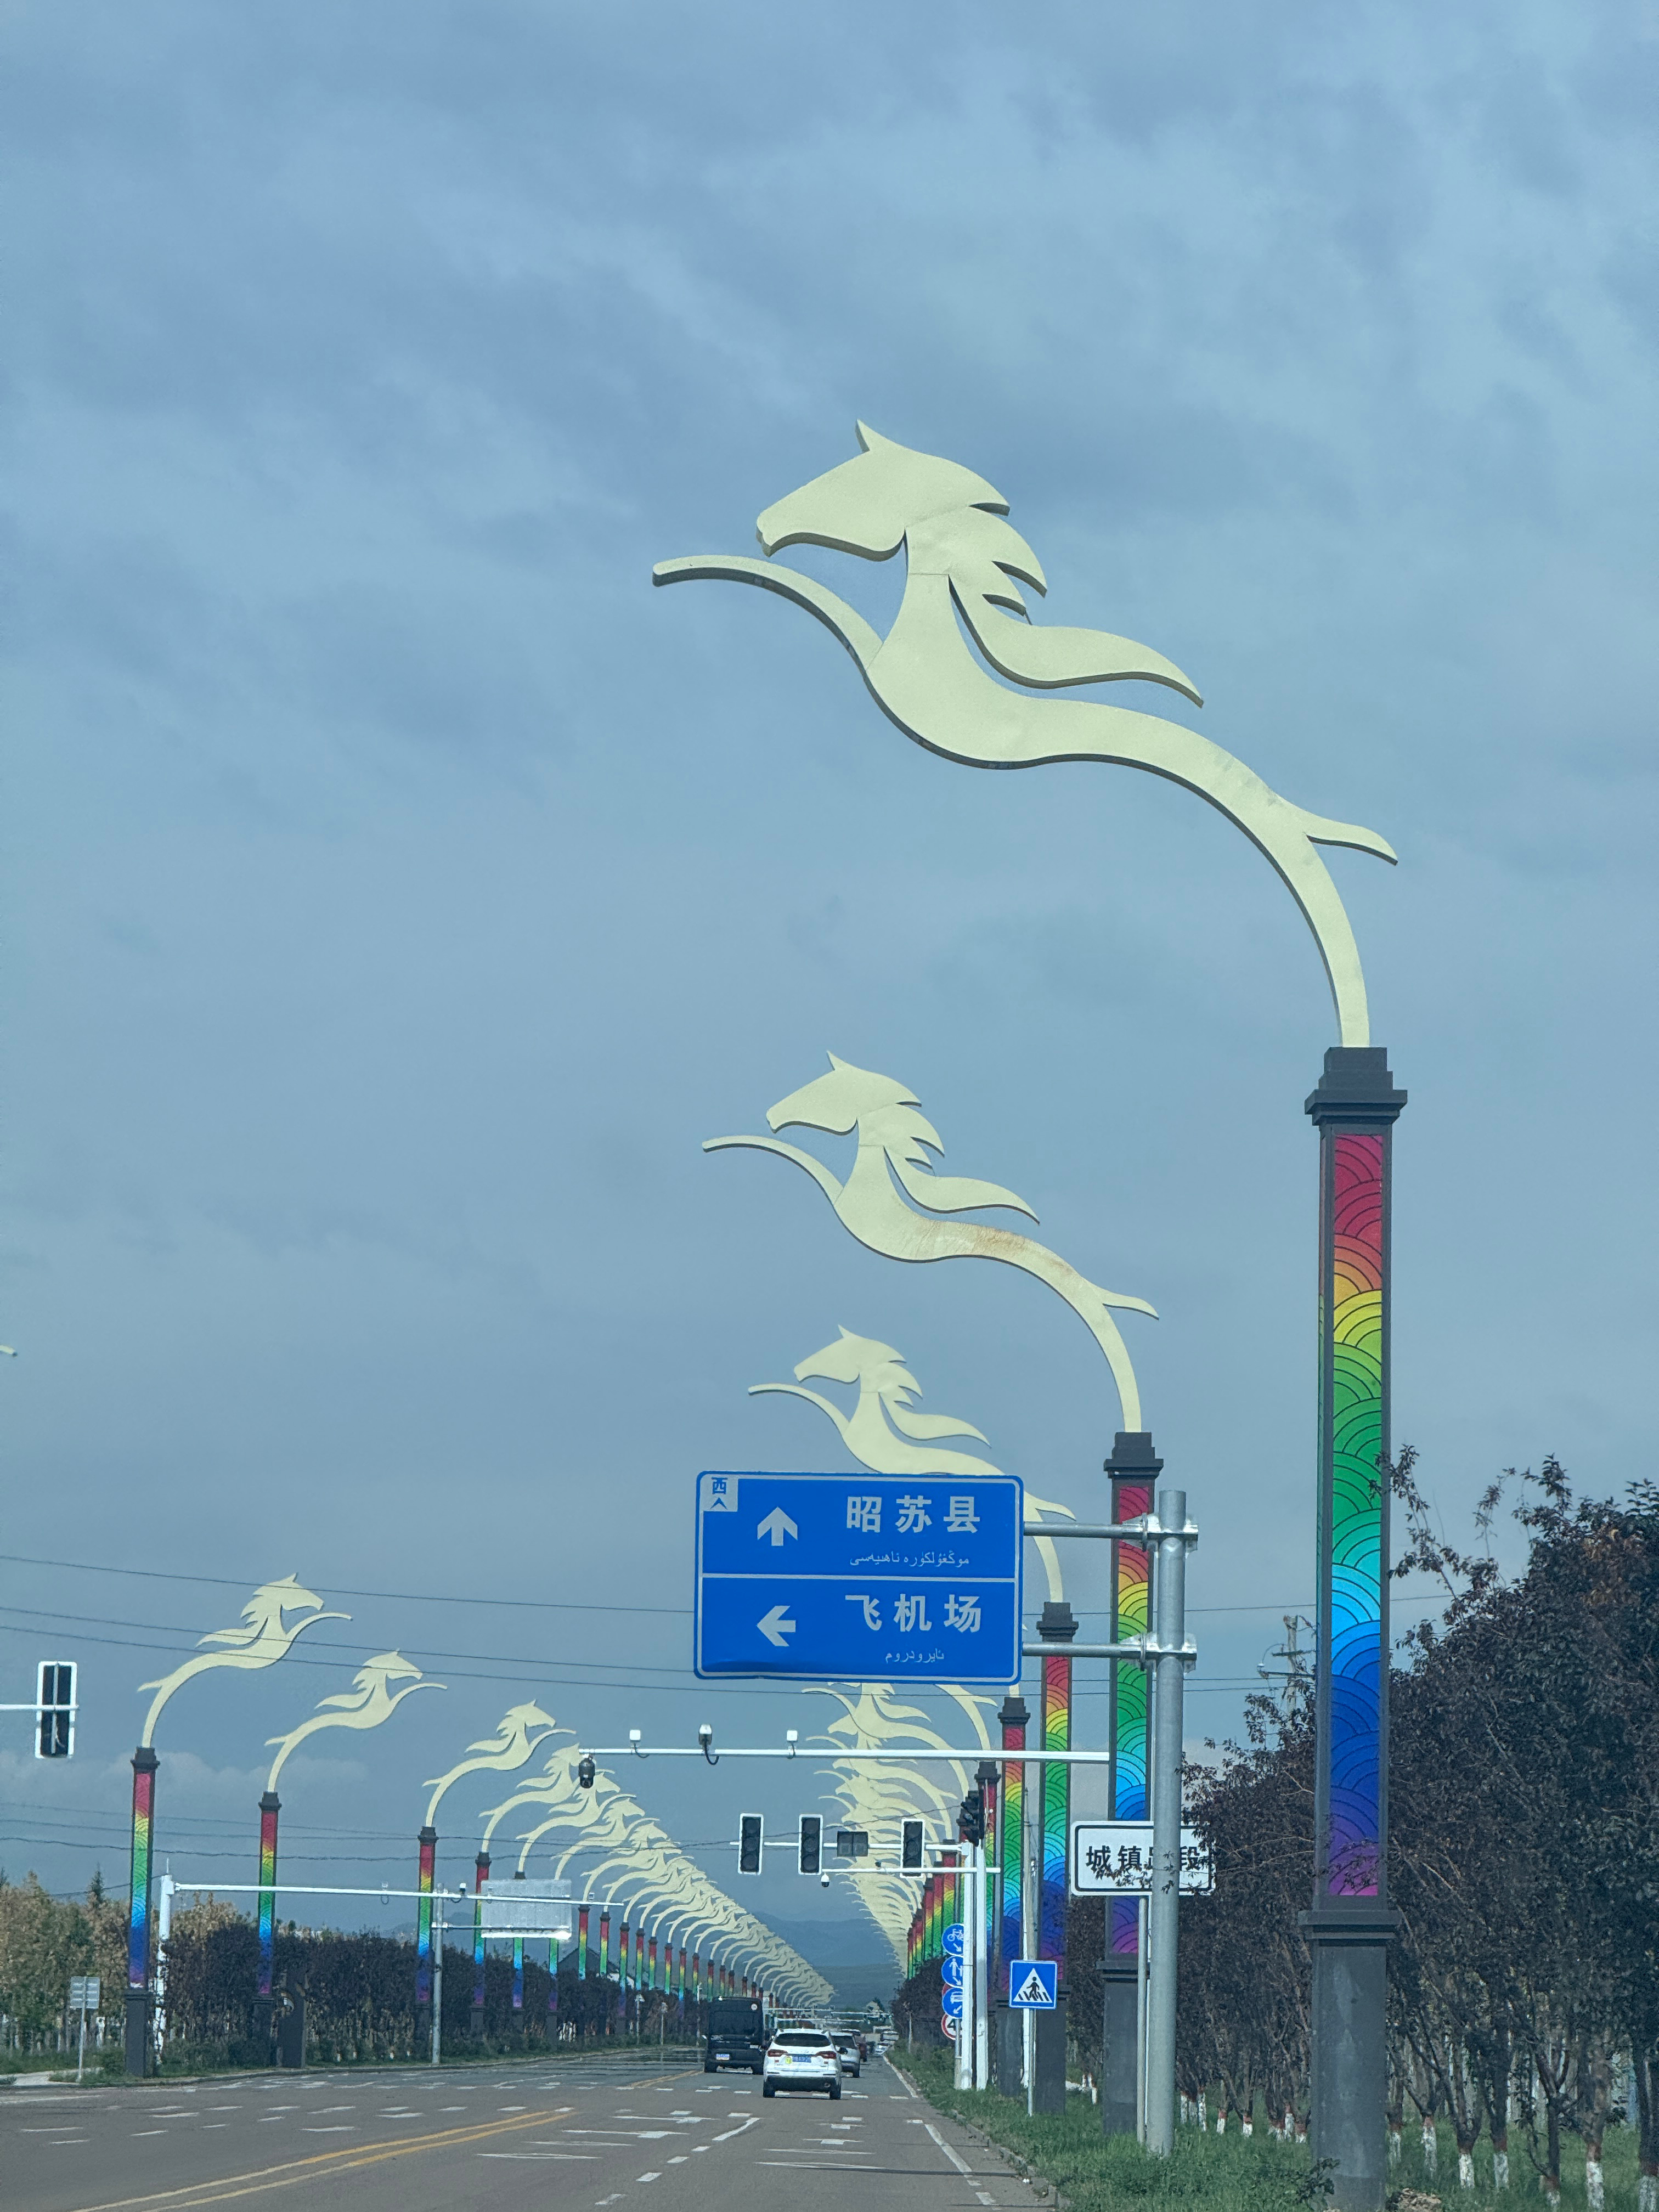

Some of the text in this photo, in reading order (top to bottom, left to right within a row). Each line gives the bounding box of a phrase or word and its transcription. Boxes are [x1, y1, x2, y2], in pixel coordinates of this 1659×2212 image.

[711, 1477, 728, 1495] 西
[846, 1494, 980, 1533] 昭苏县
[845, 1593, 981, 1633] 飞机场
[1086, 1845, 1201, 1872] 城镇段
